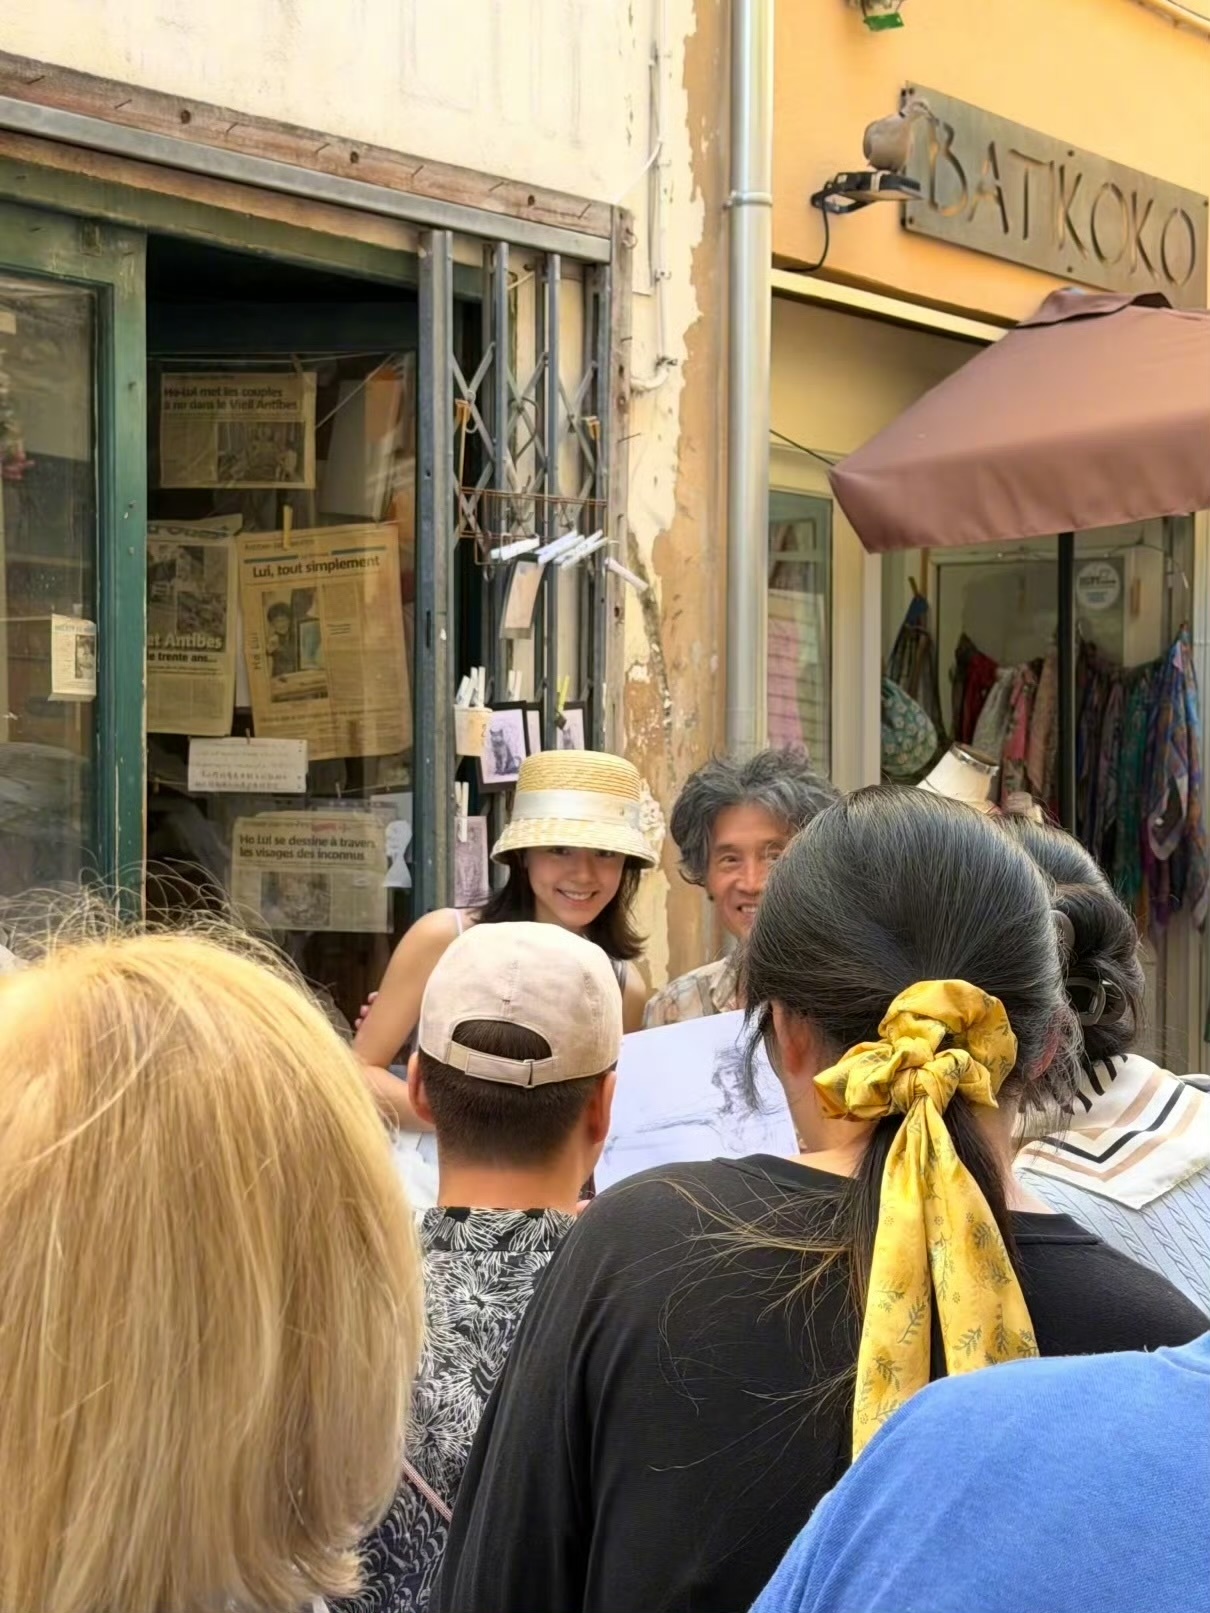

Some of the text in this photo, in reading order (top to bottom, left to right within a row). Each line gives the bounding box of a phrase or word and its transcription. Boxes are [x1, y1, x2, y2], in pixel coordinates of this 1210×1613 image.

[200, 387, 220, 397] met
[242, 386, 282, 398] couples
[189, 399, 214, 410] dans
[256, 399, 297, 410] Antibes
[253, 555, 380, 578] Lui, tout simplement
[164, 632, 222, 649] Antibes
[158, 653, 188, 662] trente
[239, 834, 254, 844] Ho
[257, 834, 272, 845] Lui
[275, 836, 286, 845] se
[288, 835, 329, 847] dessine
[239, 847, 365, 861] les visages des inconnus
